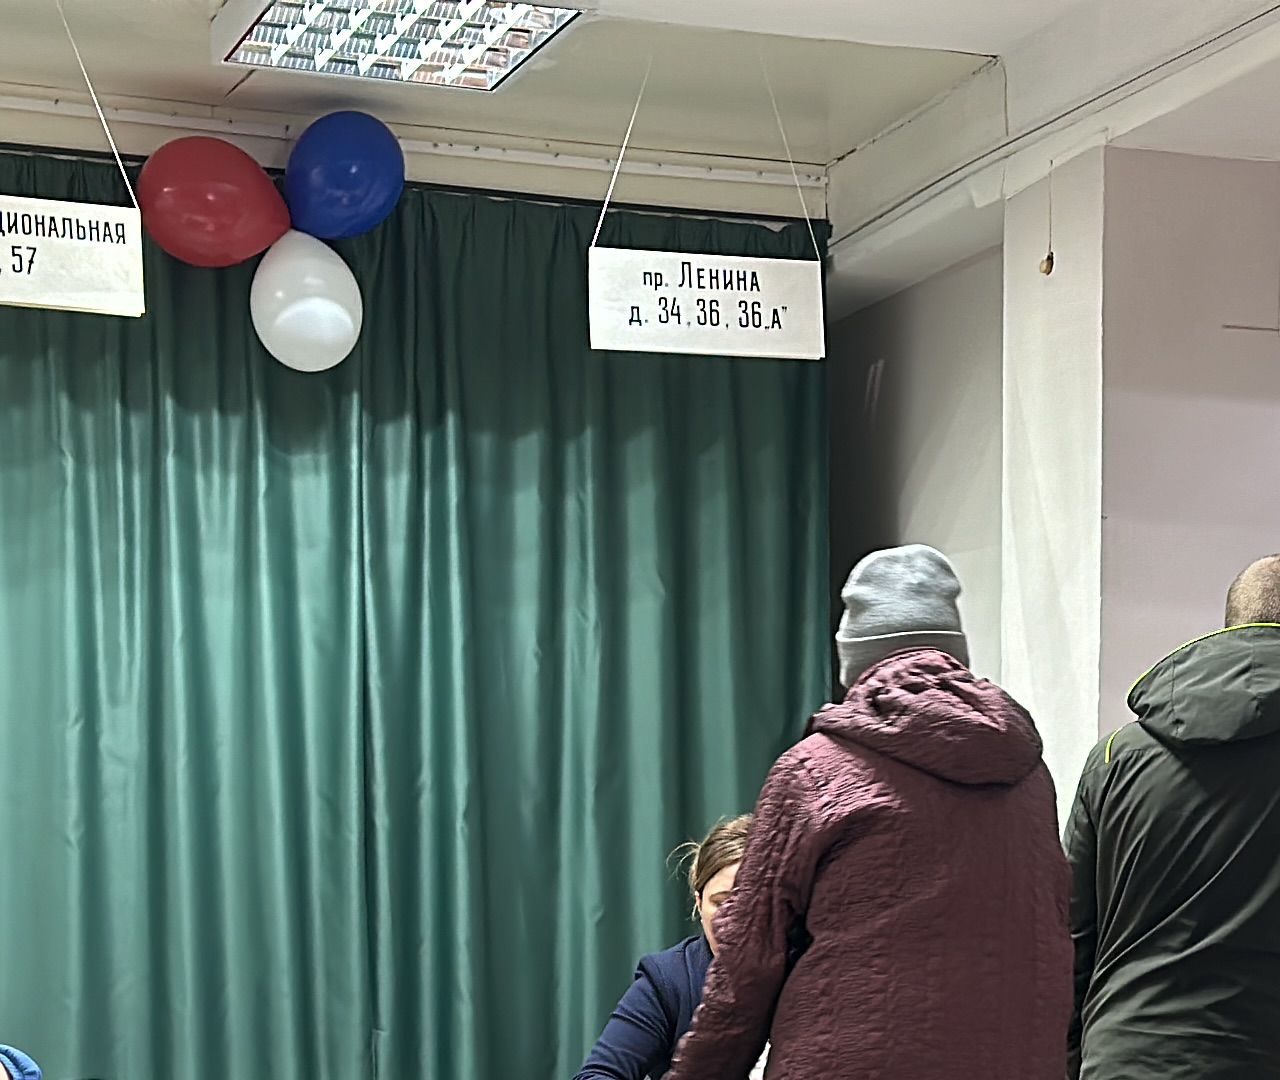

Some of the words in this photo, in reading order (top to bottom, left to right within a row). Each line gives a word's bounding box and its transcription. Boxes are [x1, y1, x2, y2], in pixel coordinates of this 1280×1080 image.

[11, 245, 38, 276] 57
[642, 270, 669, 292] пр.
[678, 261, 762, 293] ЛЕНИНА
[628, 305, 650, 327] д.
